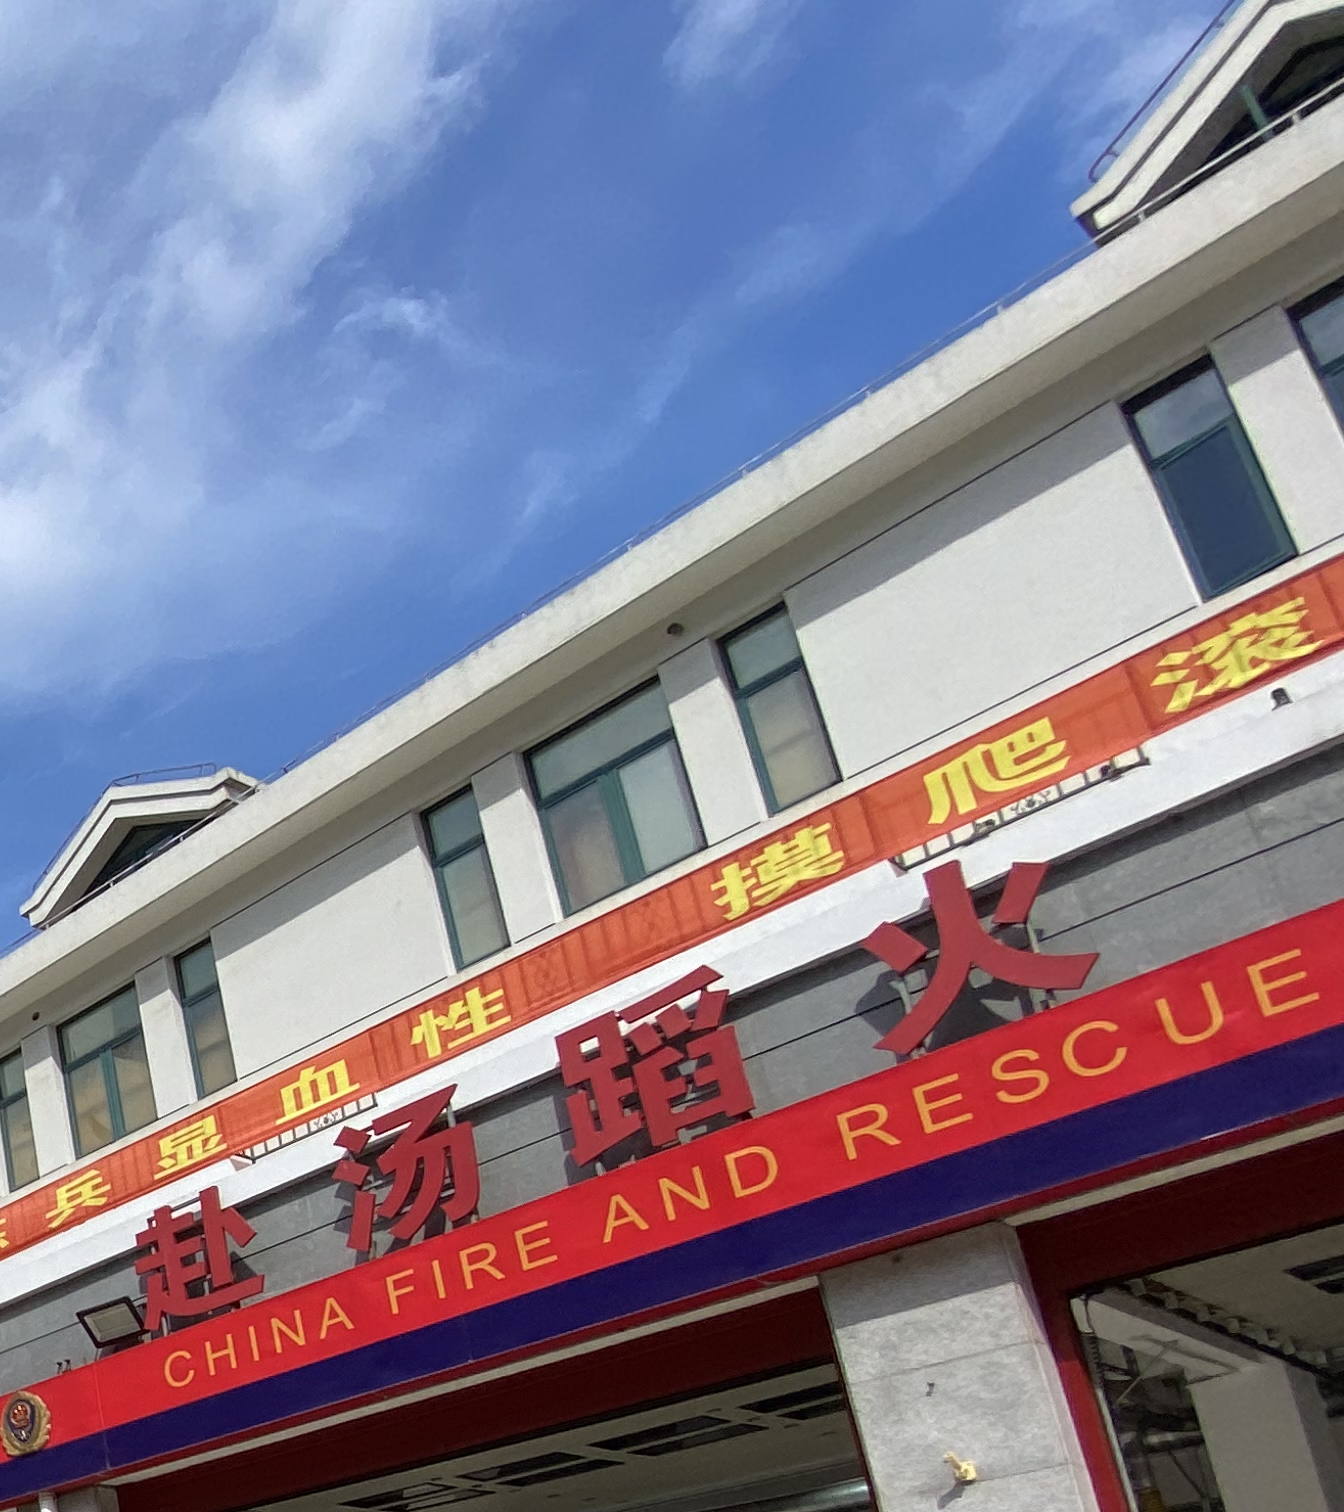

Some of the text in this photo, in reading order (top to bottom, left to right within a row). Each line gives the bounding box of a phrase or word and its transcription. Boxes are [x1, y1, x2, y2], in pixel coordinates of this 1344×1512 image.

[711, 597, 1322, 921] 摸爬滚
[134, 860, 1100, 1332] 赴汤蹈火
[163, 948, 1320, 1388] CHINA FIRE AND RESCUE
